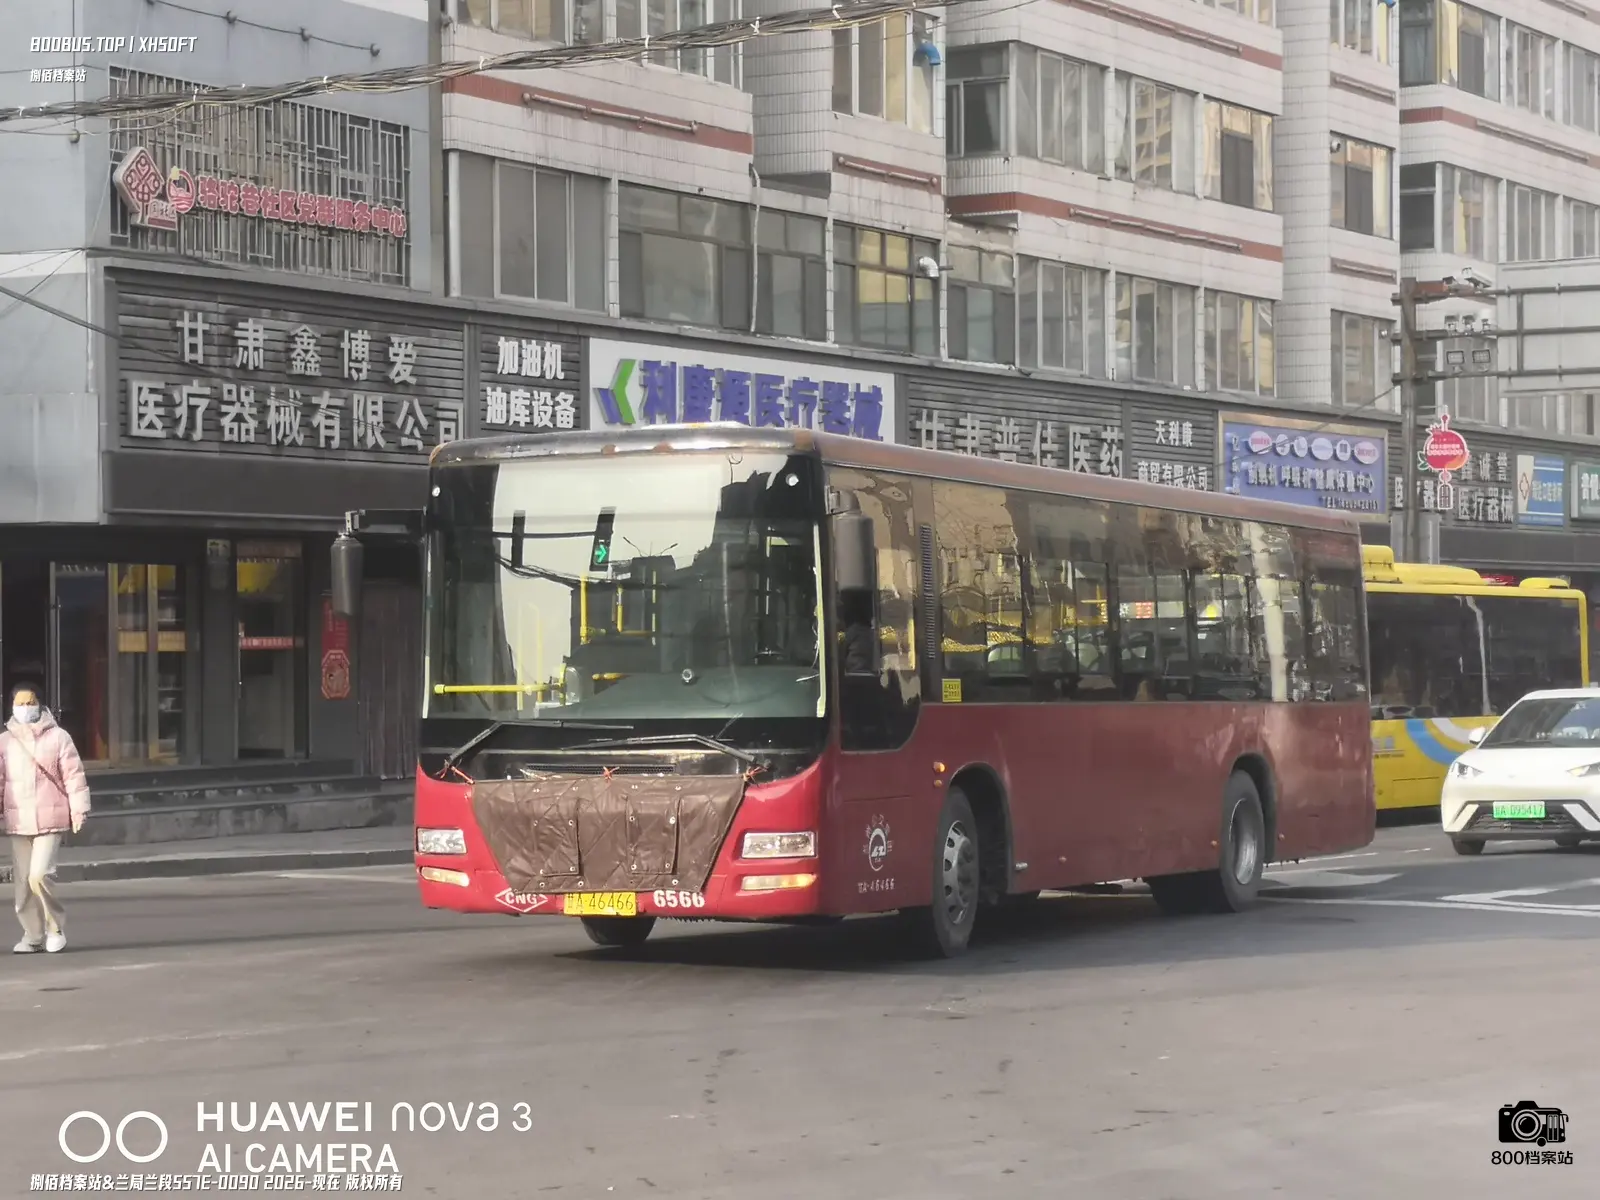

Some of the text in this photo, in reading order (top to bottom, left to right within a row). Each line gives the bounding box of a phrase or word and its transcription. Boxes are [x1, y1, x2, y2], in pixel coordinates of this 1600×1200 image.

[176, 311, 418, 385] 甘肃鑫博爱
[497, 336, 565, 380] 加油机
[131, 379, 464, 451] 医疗器械有限公司
[485, 386, 576, 429] 油库设备
[1458, 487, 1514, 523] 医疗器械
[504, 891, 538, 905] CNG
[653, 889, 705, 908] 6566
